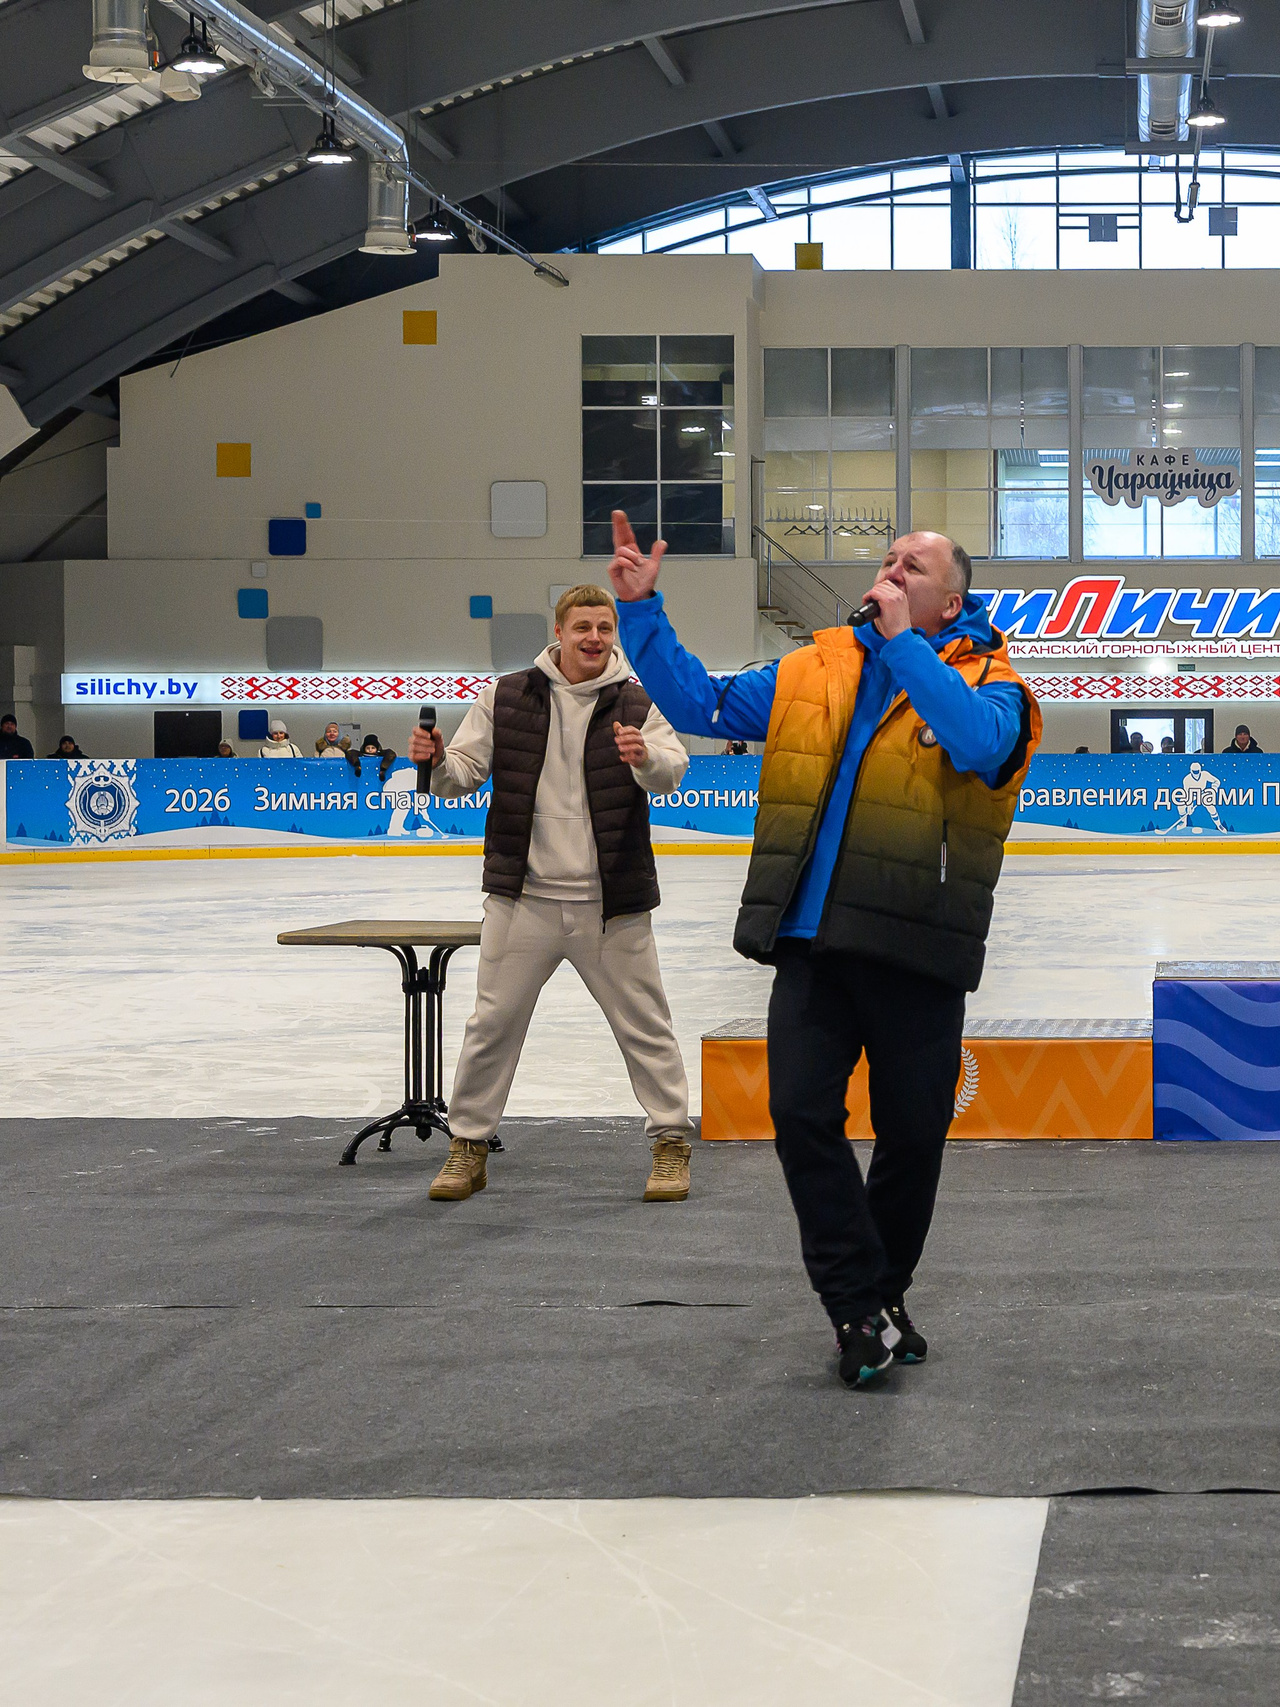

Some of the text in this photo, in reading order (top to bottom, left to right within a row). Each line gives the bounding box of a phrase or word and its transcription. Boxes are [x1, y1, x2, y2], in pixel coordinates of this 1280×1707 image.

[1136, 454, 1190, 466] КАФЕ
[1007, 641, 1098, 655] ИКАНСКИЙ
[1101, 641, 1237, 655] ГОРНОЛЫЖНЫЙ
[75, 677, 199, 700] silichy.by
[164, 787, 232, 813] 2026
[253, 786, 358, 812] Зимняя
[364, 789, 493, 816] спартаки
[1018, 787, 1148, 813] равления
[1153, 787, 1255, 811] делами
